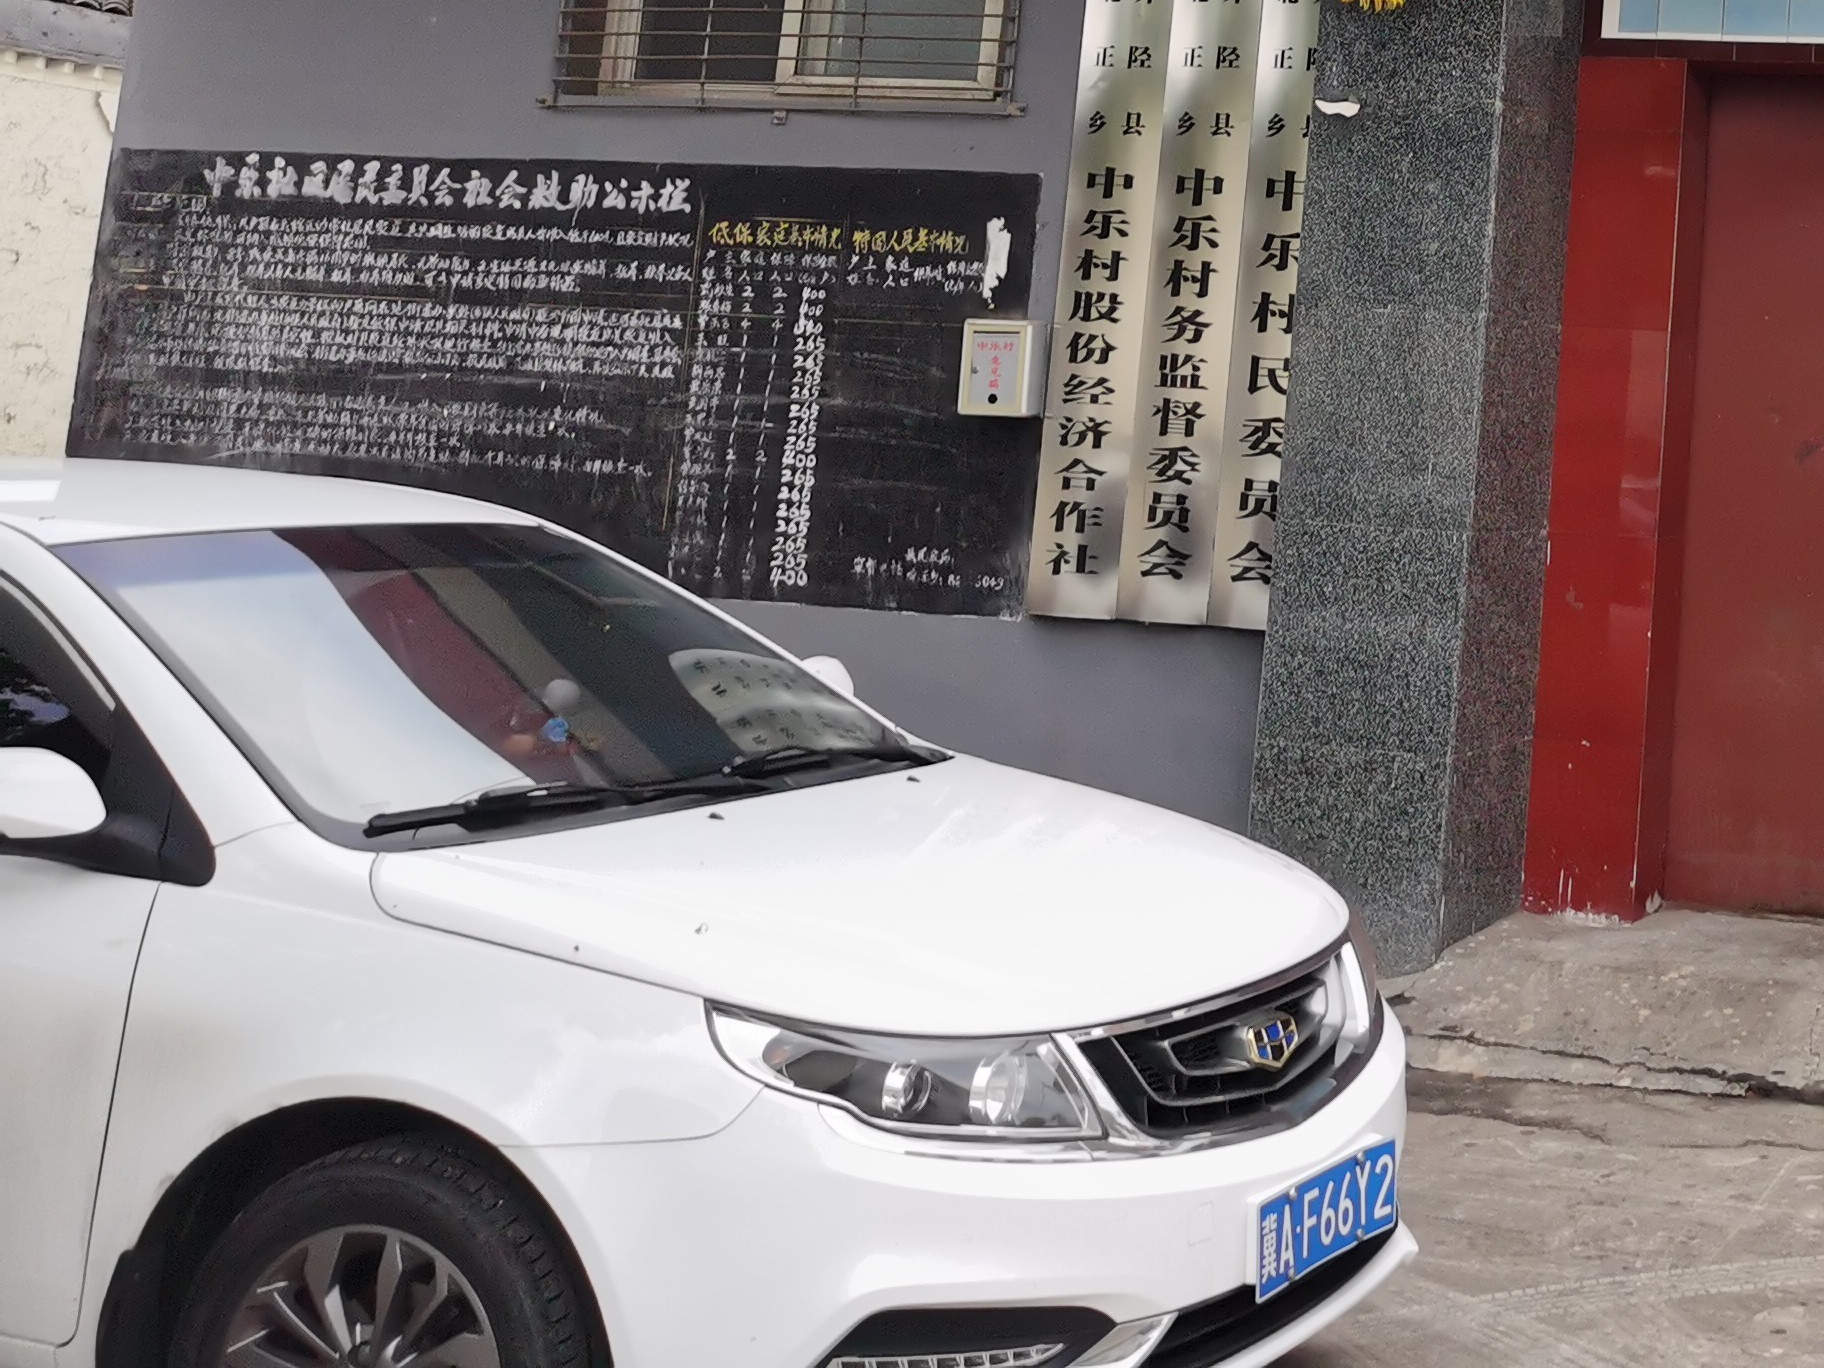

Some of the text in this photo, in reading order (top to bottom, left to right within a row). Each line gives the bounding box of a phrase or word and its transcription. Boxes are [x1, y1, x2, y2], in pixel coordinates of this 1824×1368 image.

[1046, 166, 1135, 575] 中乐村股份经济合作社
[1137, 168, 1225, 580] 中乐村务监督委员会
[1227, 170, 1307, 585] 中乐村民委员会
